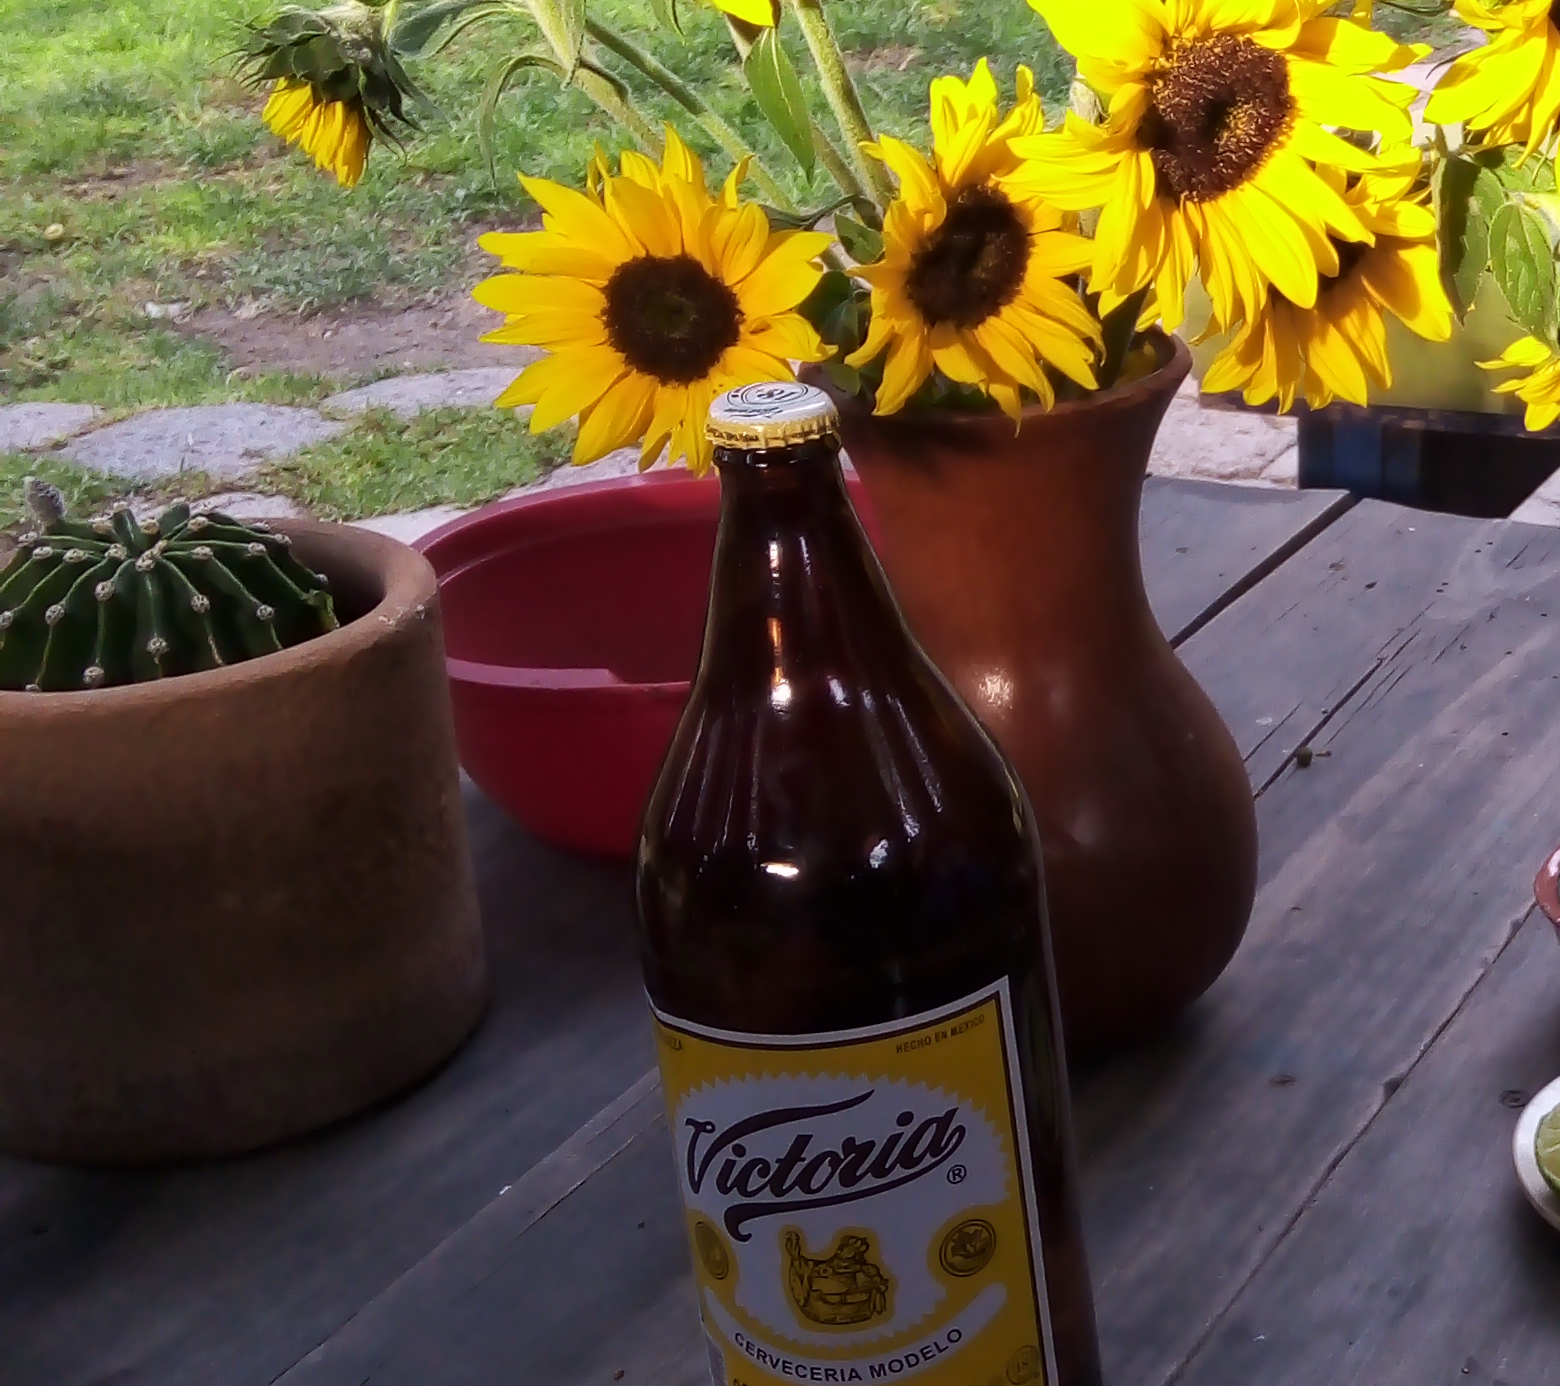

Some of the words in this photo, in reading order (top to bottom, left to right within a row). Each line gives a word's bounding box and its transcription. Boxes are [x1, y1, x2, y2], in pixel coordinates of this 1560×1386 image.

[895, 1035, 932, 1054] HECHO
[934, 1030, 948, 1043] EN
[684, 1089, 967, 1241] Victoria
[734, 1332, 862, 1382] CERVECERIA
[868, 1328, 963, 1379] MODELO
